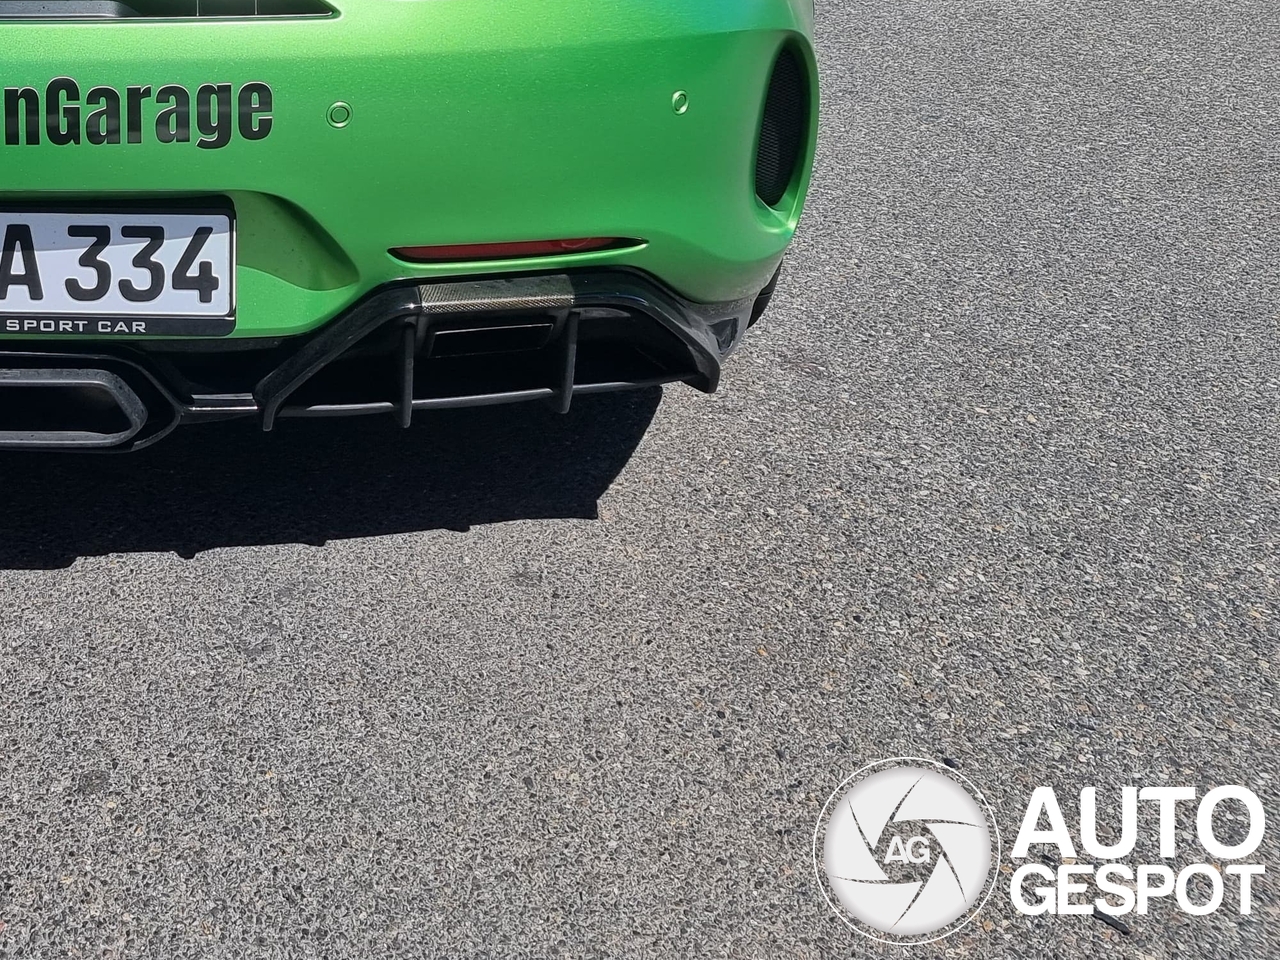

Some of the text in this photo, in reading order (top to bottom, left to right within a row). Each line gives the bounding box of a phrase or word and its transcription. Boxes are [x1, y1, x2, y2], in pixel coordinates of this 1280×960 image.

[64, 225, 221, 304] 334
[6, 319, 88, 332] SPORT
[97, 321, 147, 333] CAR
